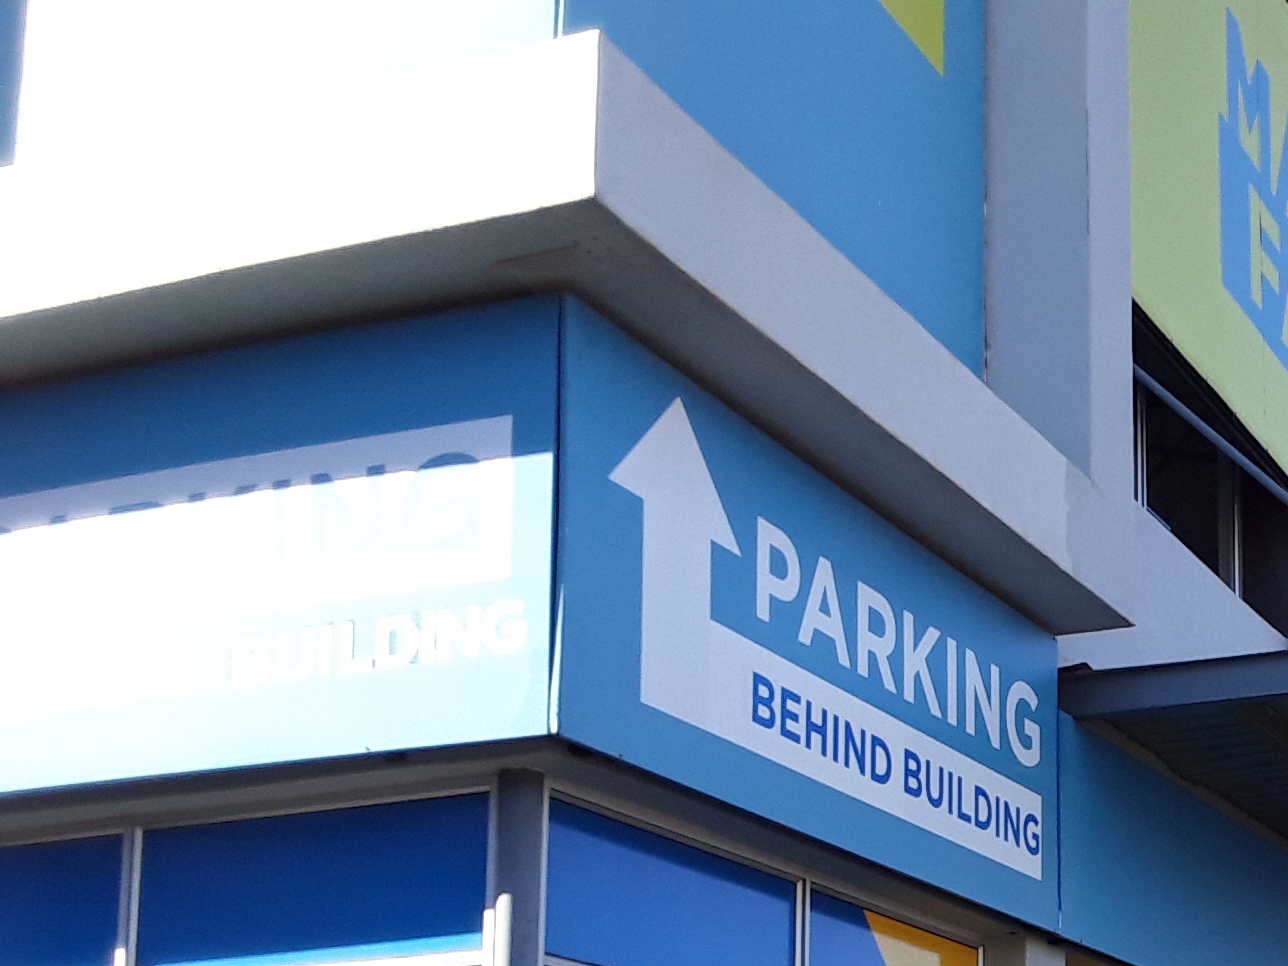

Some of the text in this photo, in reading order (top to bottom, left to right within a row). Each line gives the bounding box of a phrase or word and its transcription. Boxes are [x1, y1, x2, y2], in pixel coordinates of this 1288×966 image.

[756, 515, 1042, 767] PARKING
[751, 671, 1041, 856] BEHIND BUILDING
